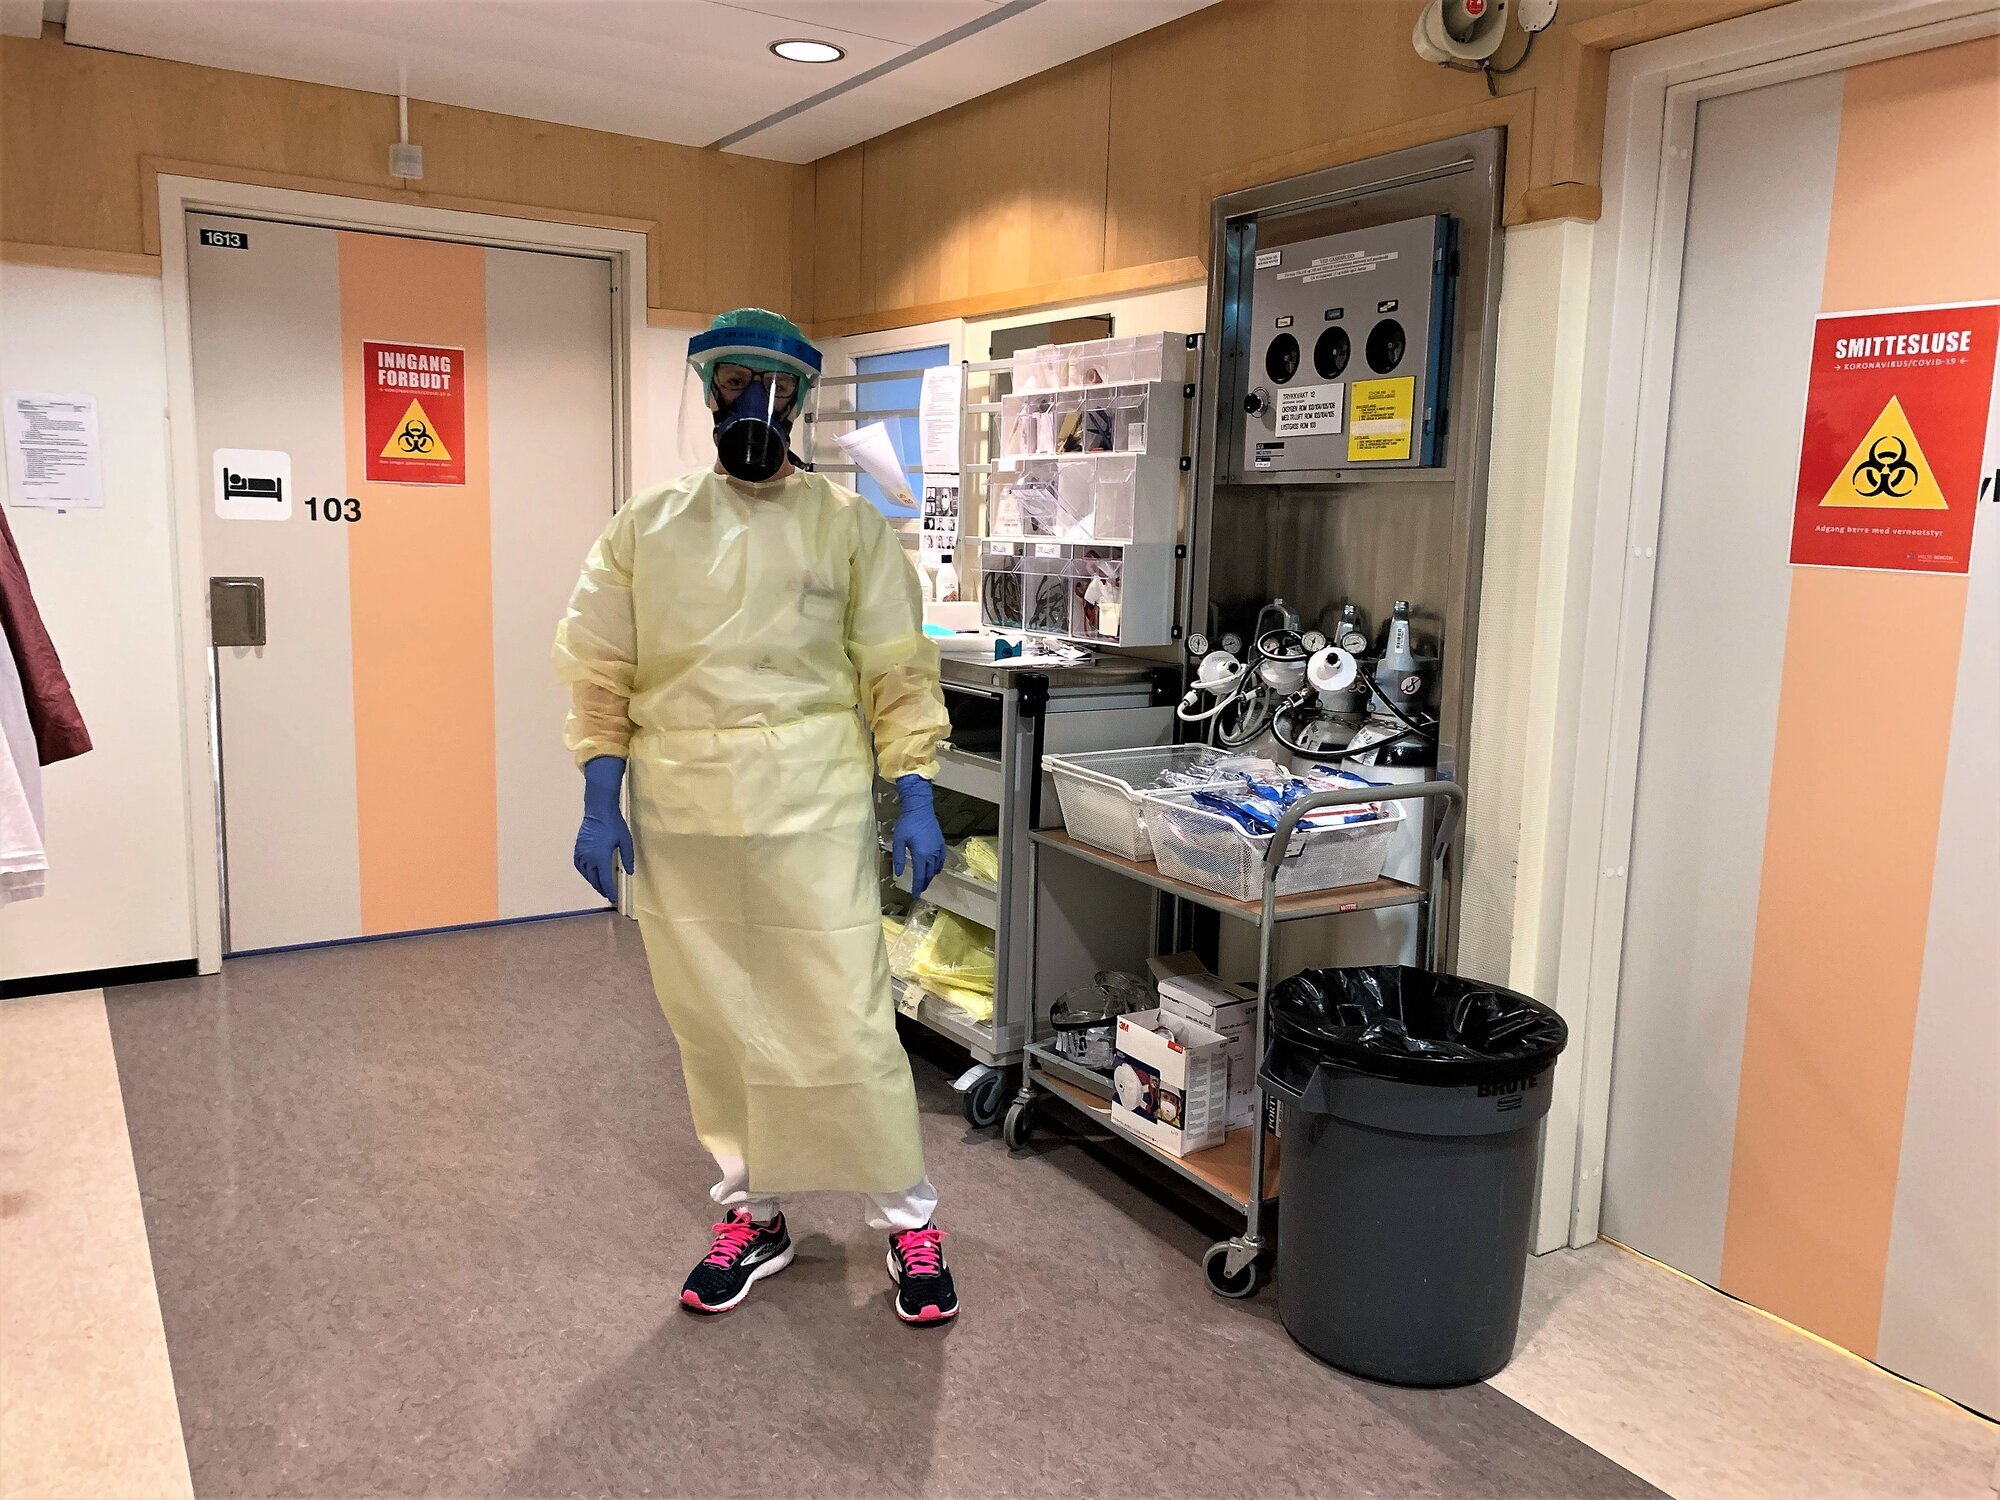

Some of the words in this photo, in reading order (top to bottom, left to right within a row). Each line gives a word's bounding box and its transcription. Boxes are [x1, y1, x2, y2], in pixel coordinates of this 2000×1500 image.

[205, 231, 241, 247] 1613
[1835, 330, 1972, 359] SMITTESLUSE
[378, 351, 451, 372] INNGANG
[1844, 357, 1956, 370] KORONAVIRUS/COVID-19
[378, 369, 451, 390] FORBUDT
[304, 496, 362, 522] 103
[1815, 525, 1845, 534] Adgang
[1847, 526, 1870, 534] berre
[1872, 527, 1890, 535] med
[1892, 528, 1944, 538] verneutstyr
[1118, 1021, 1129, 1032] 3M
